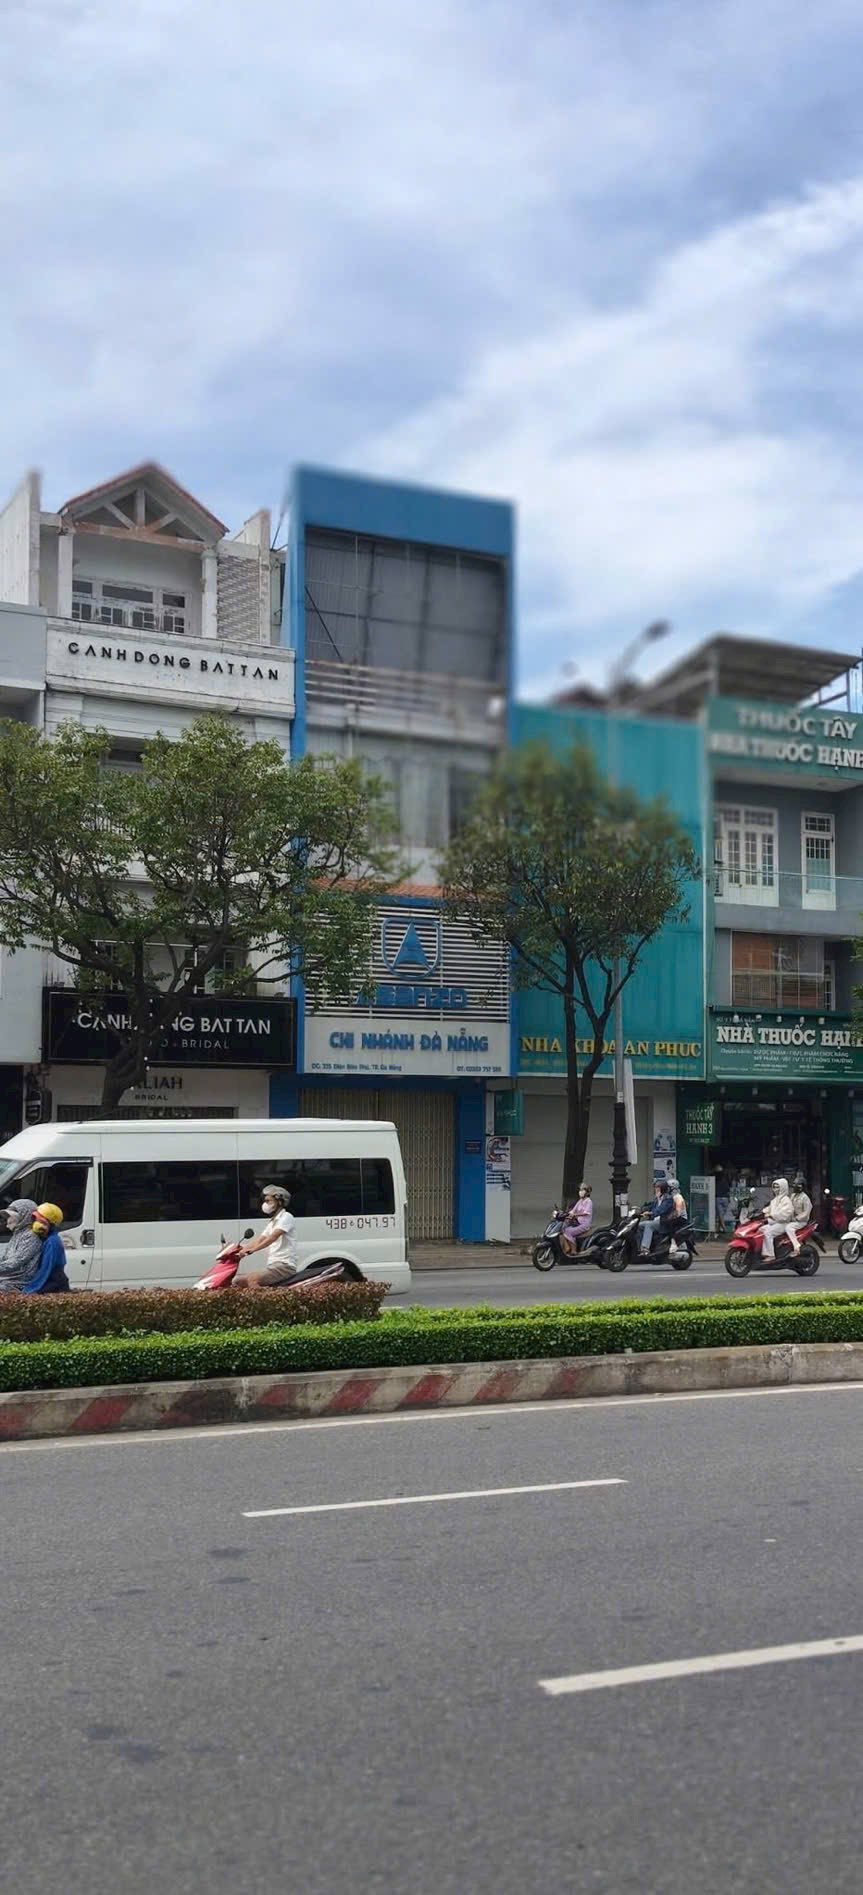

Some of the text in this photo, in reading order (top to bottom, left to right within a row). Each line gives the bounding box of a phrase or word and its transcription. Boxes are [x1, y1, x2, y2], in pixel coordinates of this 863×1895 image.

[134, 651, 191, 669] DONG
[819, 715, 858, 739] TÂY
[181, 1039, 230, 1049] BRIDAL
[329, 1027, 489, 1051] CHI NHÁNH ĐÀ NẴNG
[716, 1022, 755, 1043] NHÀ
[758, 1023, 816, 1046] THUỐC
[521, 1036, 562, 1053] NHA
[624, 1040, 650, 1056] AN
[357, 1216, 396, 1229] 047.97
